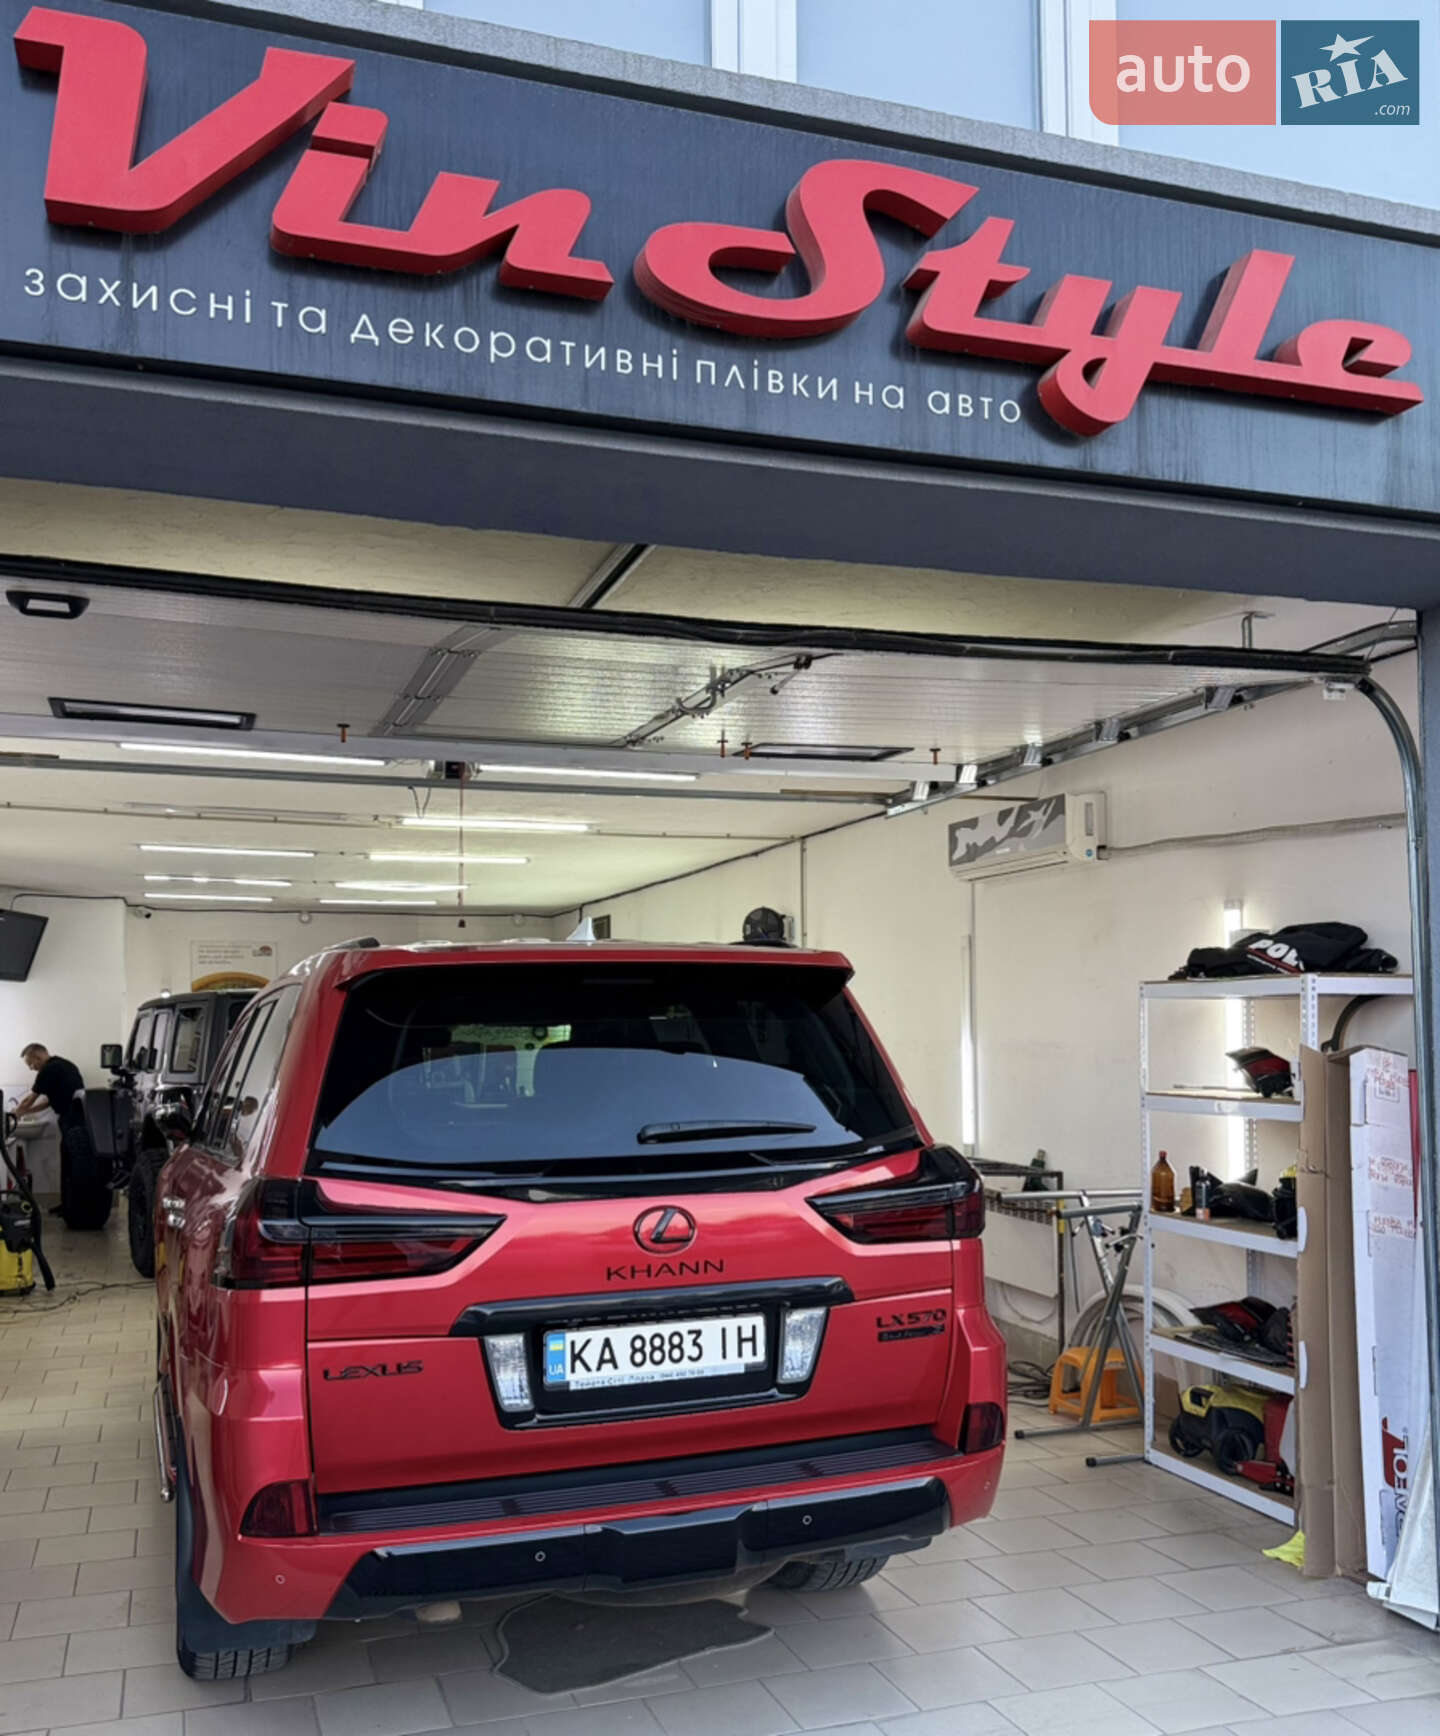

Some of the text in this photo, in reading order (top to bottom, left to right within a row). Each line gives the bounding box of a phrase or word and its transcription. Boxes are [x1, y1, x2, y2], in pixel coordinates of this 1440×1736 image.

[23, 267, 1022, 424] захисні та декоративні плівки на авто
[605, 1259, 725, 1281] KHANN
[569, 1324, 758, 1374] KA 8883 IH
[322, 1359, 425, 1382] LEXUS
[548, 1363, 565, 1376] UA
